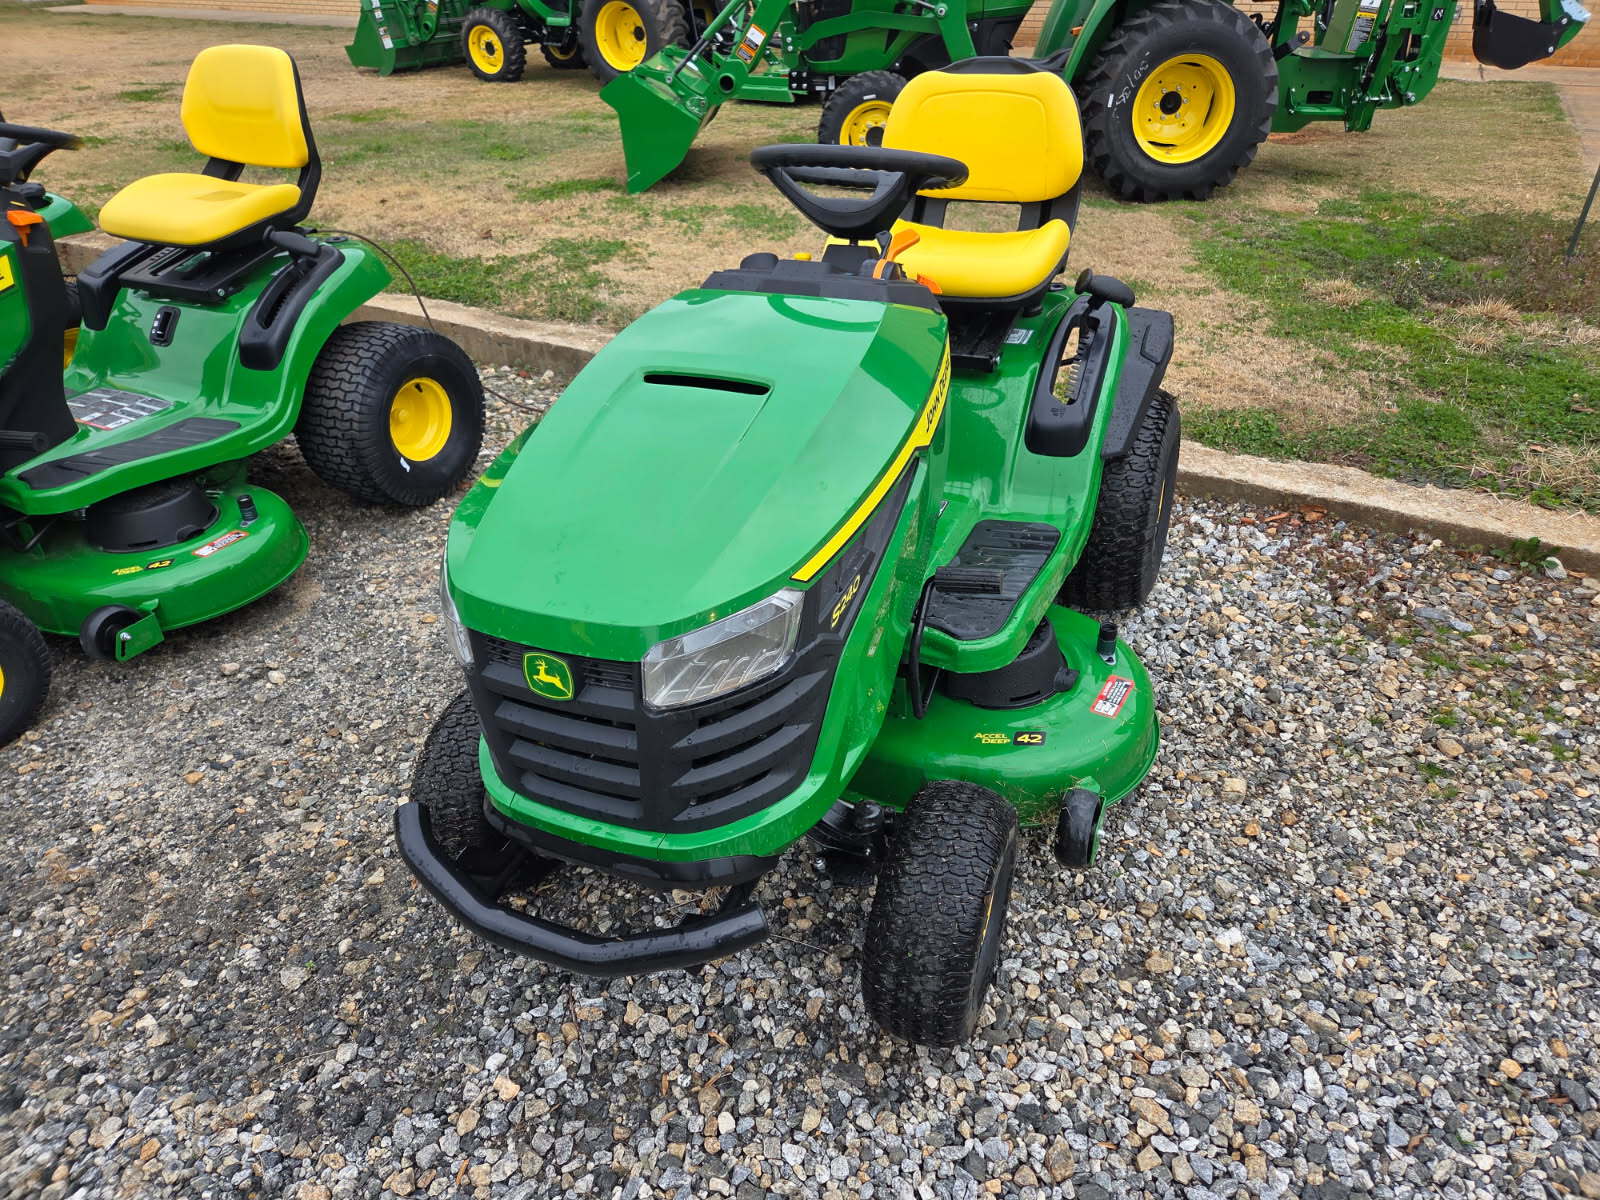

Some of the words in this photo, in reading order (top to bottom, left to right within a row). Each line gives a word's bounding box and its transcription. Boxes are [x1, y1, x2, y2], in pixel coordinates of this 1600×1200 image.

[926, 394, 940, 432] JOHN
[832, 574, 860, 628] S240
[1017, 734, 1042, 743] 42
